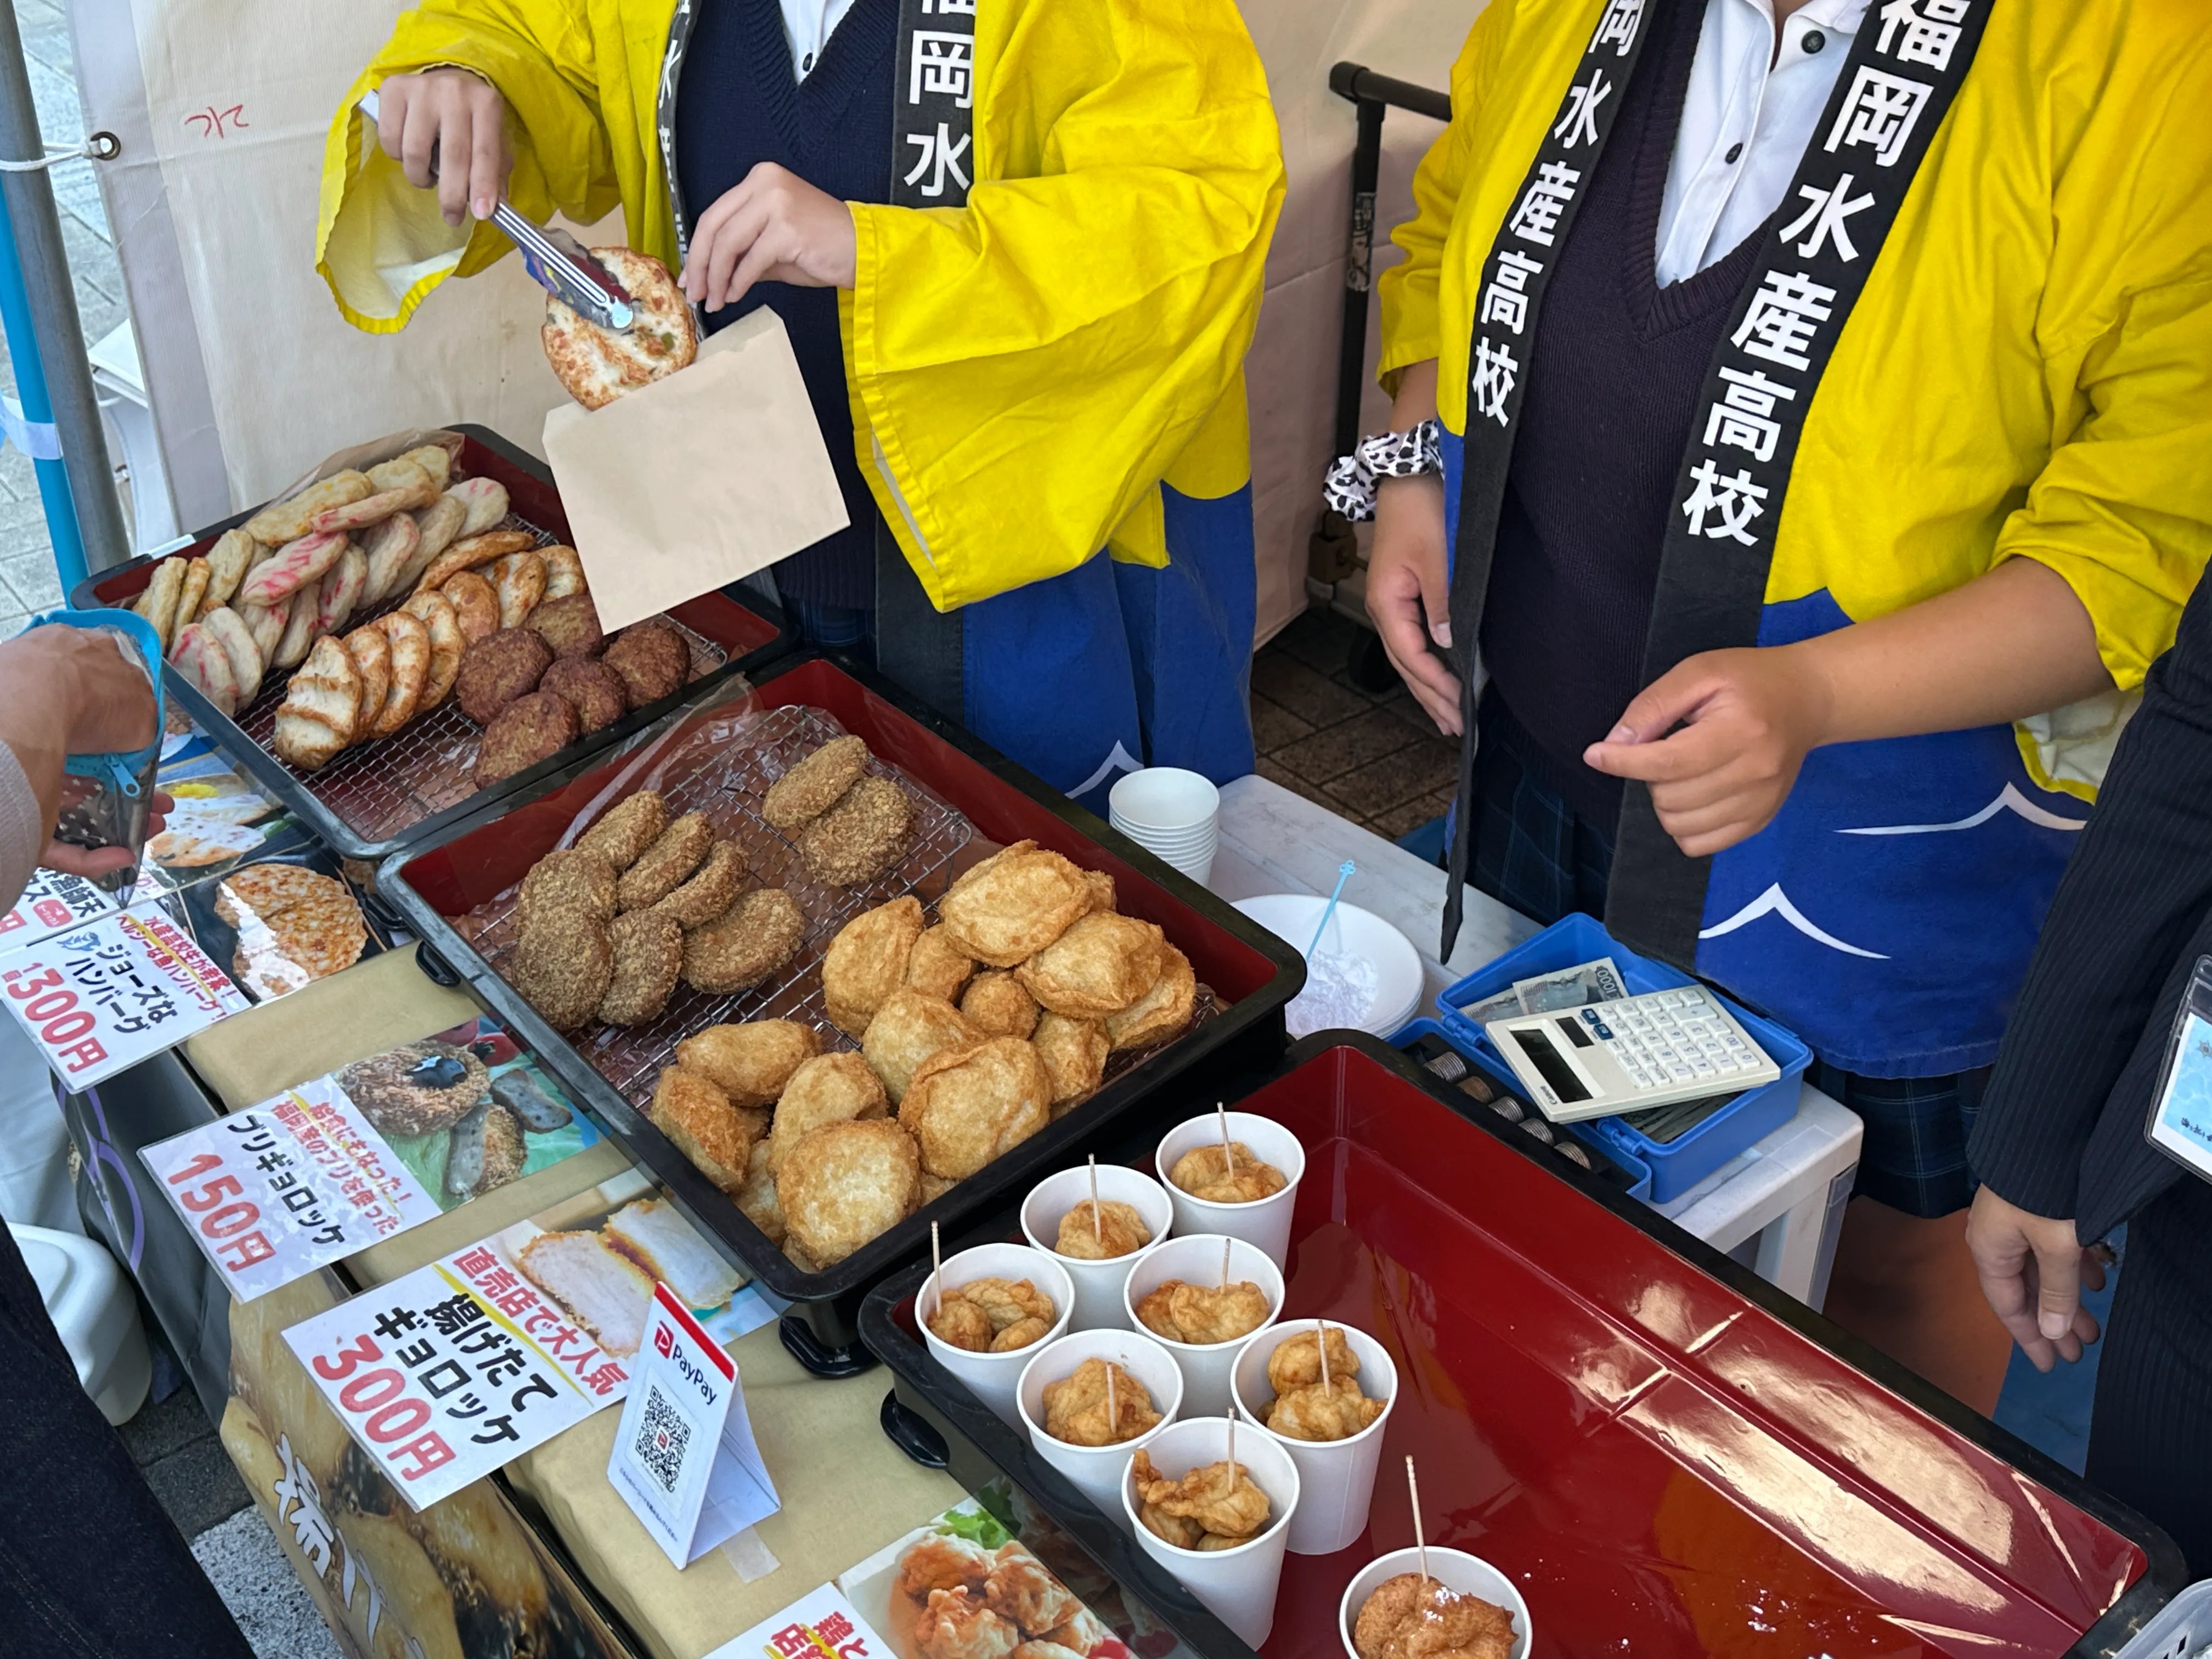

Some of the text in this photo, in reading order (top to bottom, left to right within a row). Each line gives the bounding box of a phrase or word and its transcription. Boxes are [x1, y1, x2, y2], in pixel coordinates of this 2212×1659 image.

[903, 0, 975, 197] 岡水
[1682, 0, 1971, 546] 福岡水産高校
[8, 968, 109, 1073] 300円
[65, 956, 151, 1035] ハンバーグ
[96, 944, 178, 1024] ジョーズな
[168, 1154, 276, 1272] 150円
[227, 1114, 346, 1245] ブリギョロッケ
[373, 1306, 520, 1444] ギョロッケ
[424, 1293, 557, 1413] 揚げたて
[453, 1246, 629, 1395] 直売店で大人気
[672, 1346, 718, 1406] PayPay
[313, 1335, 456, 1481] 300円
